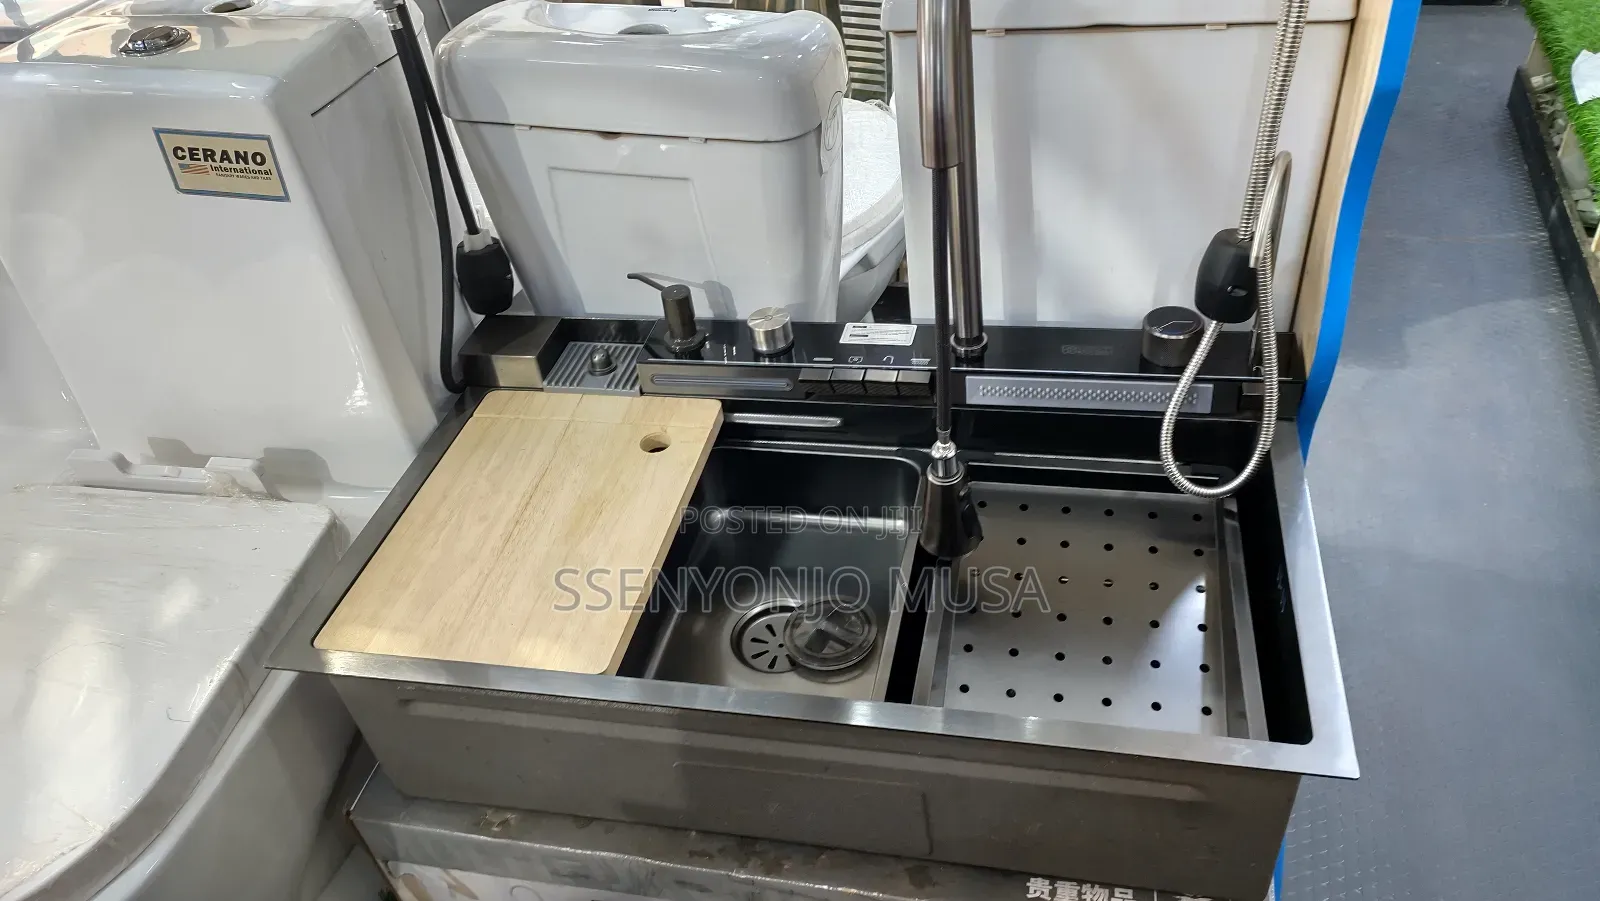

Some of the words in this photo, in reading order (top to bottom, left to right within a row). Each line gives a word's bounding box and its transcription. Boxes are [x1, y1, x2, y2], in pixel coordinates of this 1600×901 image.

[172, 145, 267, 167] CERANO
[210, 164, 273, 176] International
[1026, 877, 1137, 901] 贵重物品
